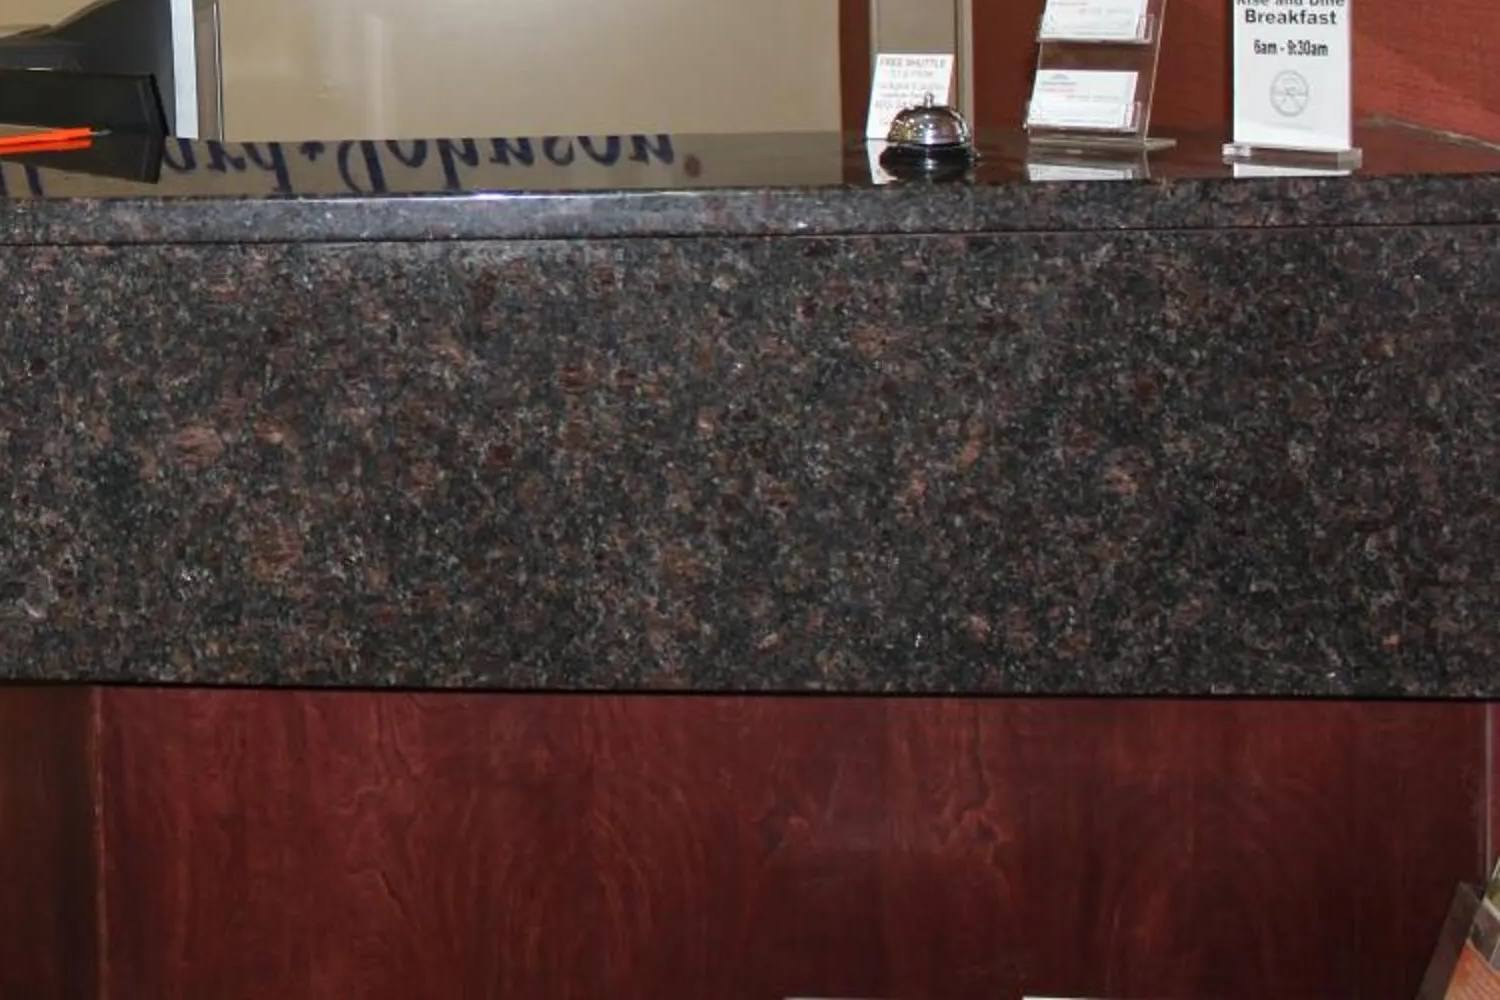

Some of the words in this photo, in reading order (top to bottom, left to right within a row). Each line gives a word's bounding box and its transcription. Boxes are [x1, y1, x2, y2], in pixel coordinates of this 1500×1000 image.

[1245, 8, 1337, 25] Breakfast
[1253, 39, 1278, 55] 6am
[1287, 39, 1329, 56] 9:30am
